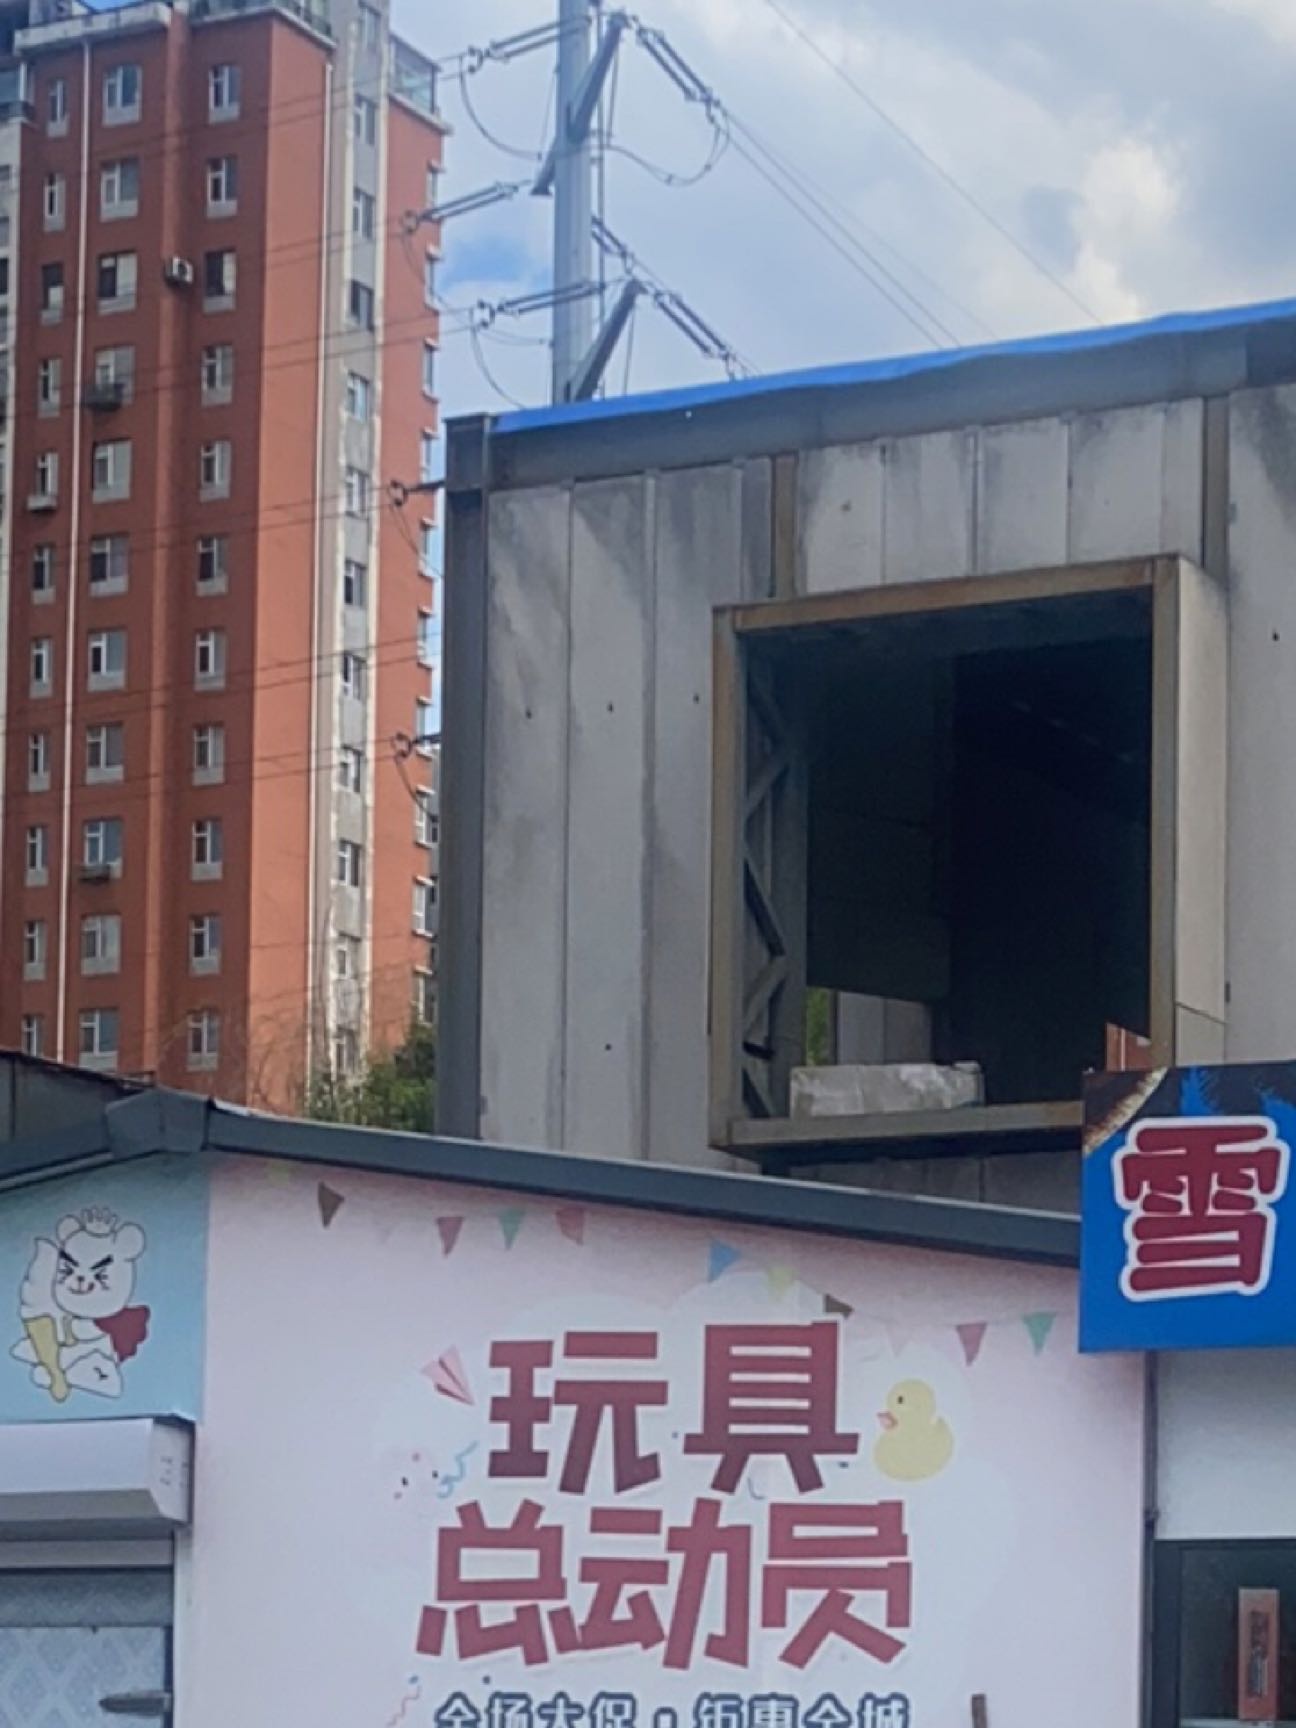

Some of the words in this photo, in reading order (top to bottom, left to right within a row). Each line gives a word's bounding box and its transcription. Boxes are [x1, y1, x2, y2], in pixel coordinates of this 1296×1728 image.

[488, 1321, 859, 1494] 玩具
[416, 1497, 912, 1670] 总动员
